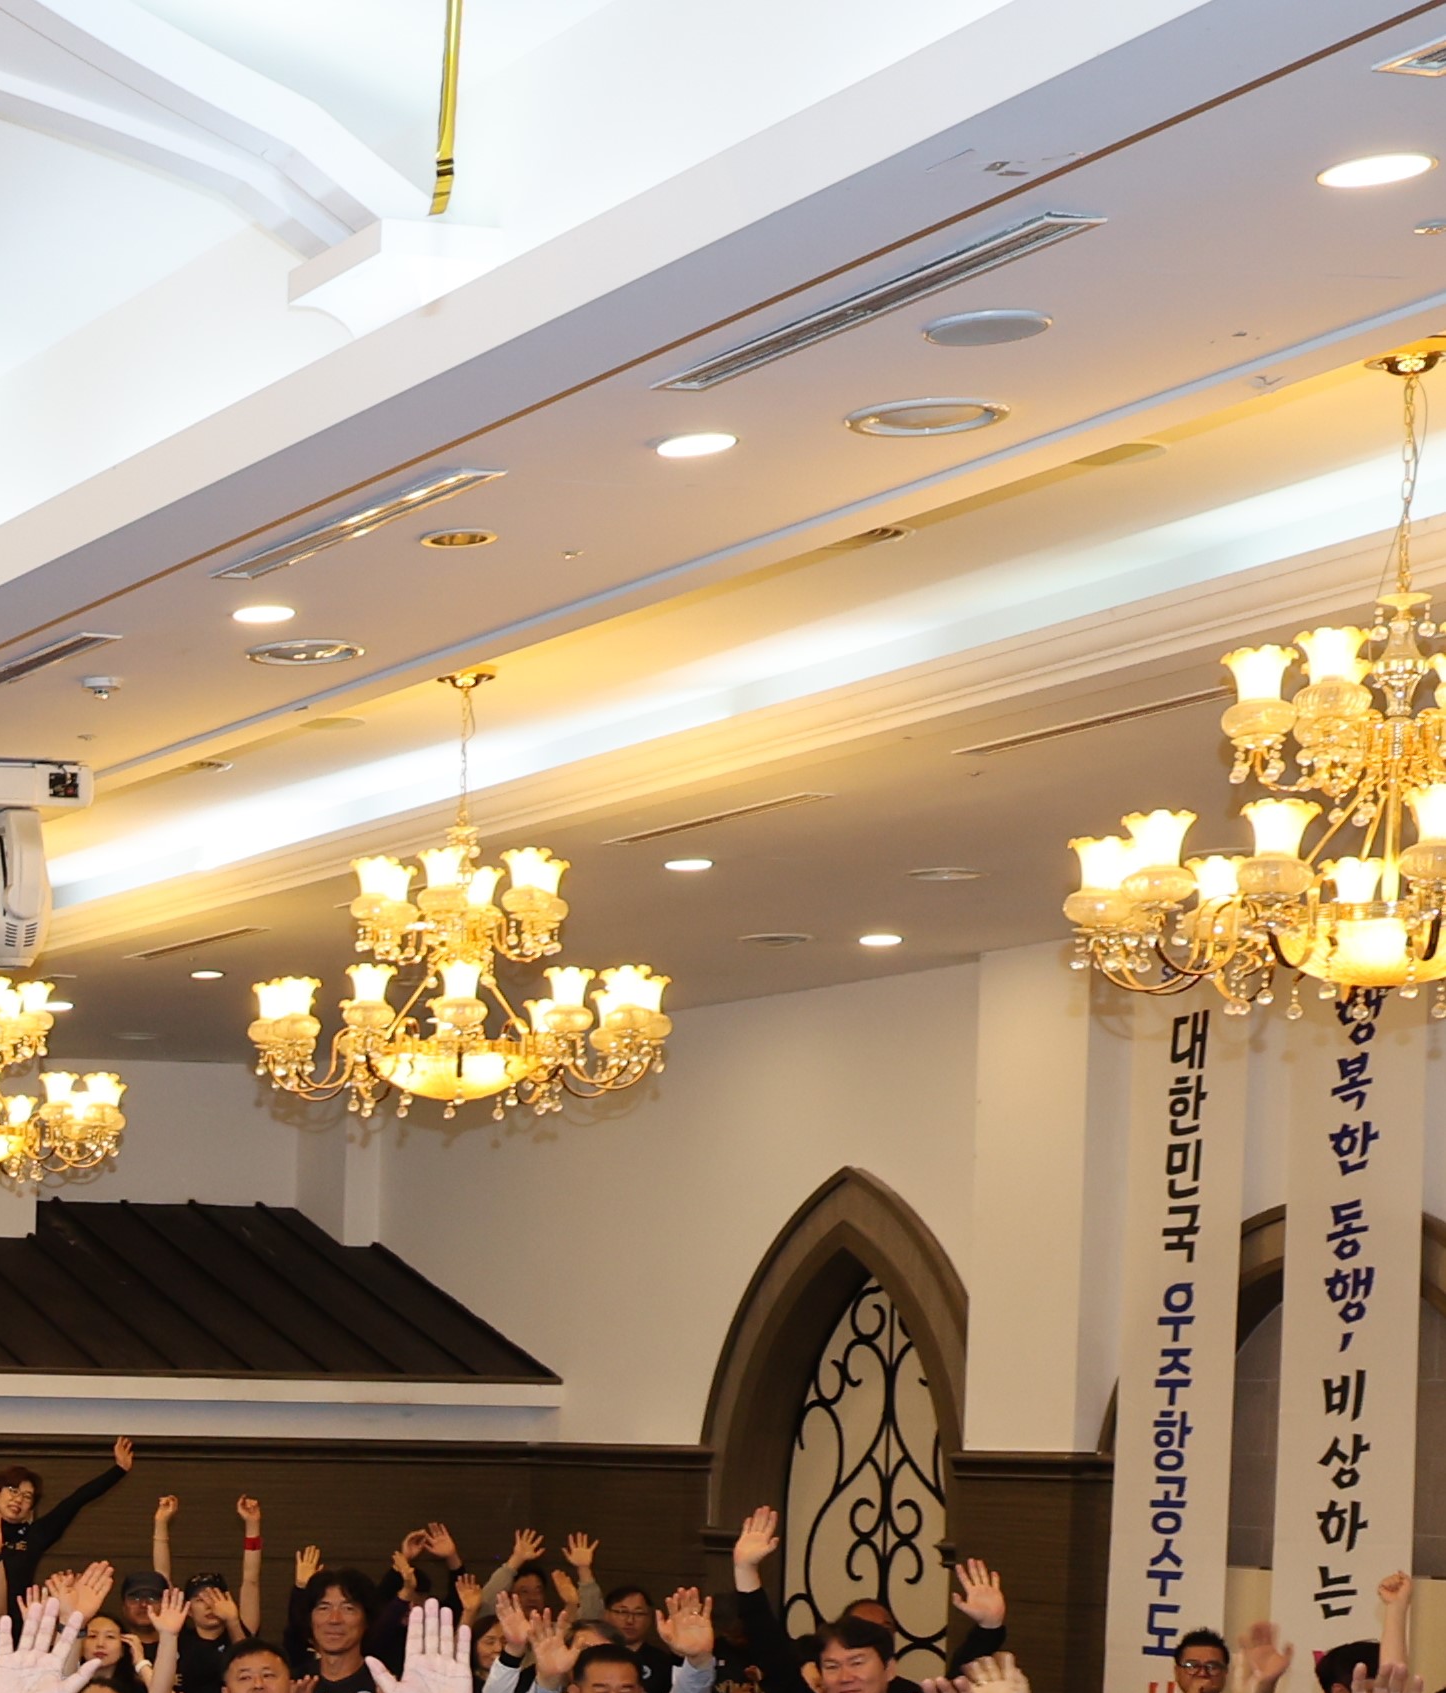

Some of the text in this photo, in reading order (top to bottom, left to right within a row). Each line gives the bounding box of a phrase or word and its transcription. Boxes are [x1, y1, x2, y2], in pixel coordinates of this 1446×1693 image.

[1161, 1010, 1210, 1263] 대한민국
[1324, 1199, 1376, 1353] 동행,
[1142, 1282, 1195, 1658] 우주항공수도
[1314, 1369, 1371, 1620] 비상하는
